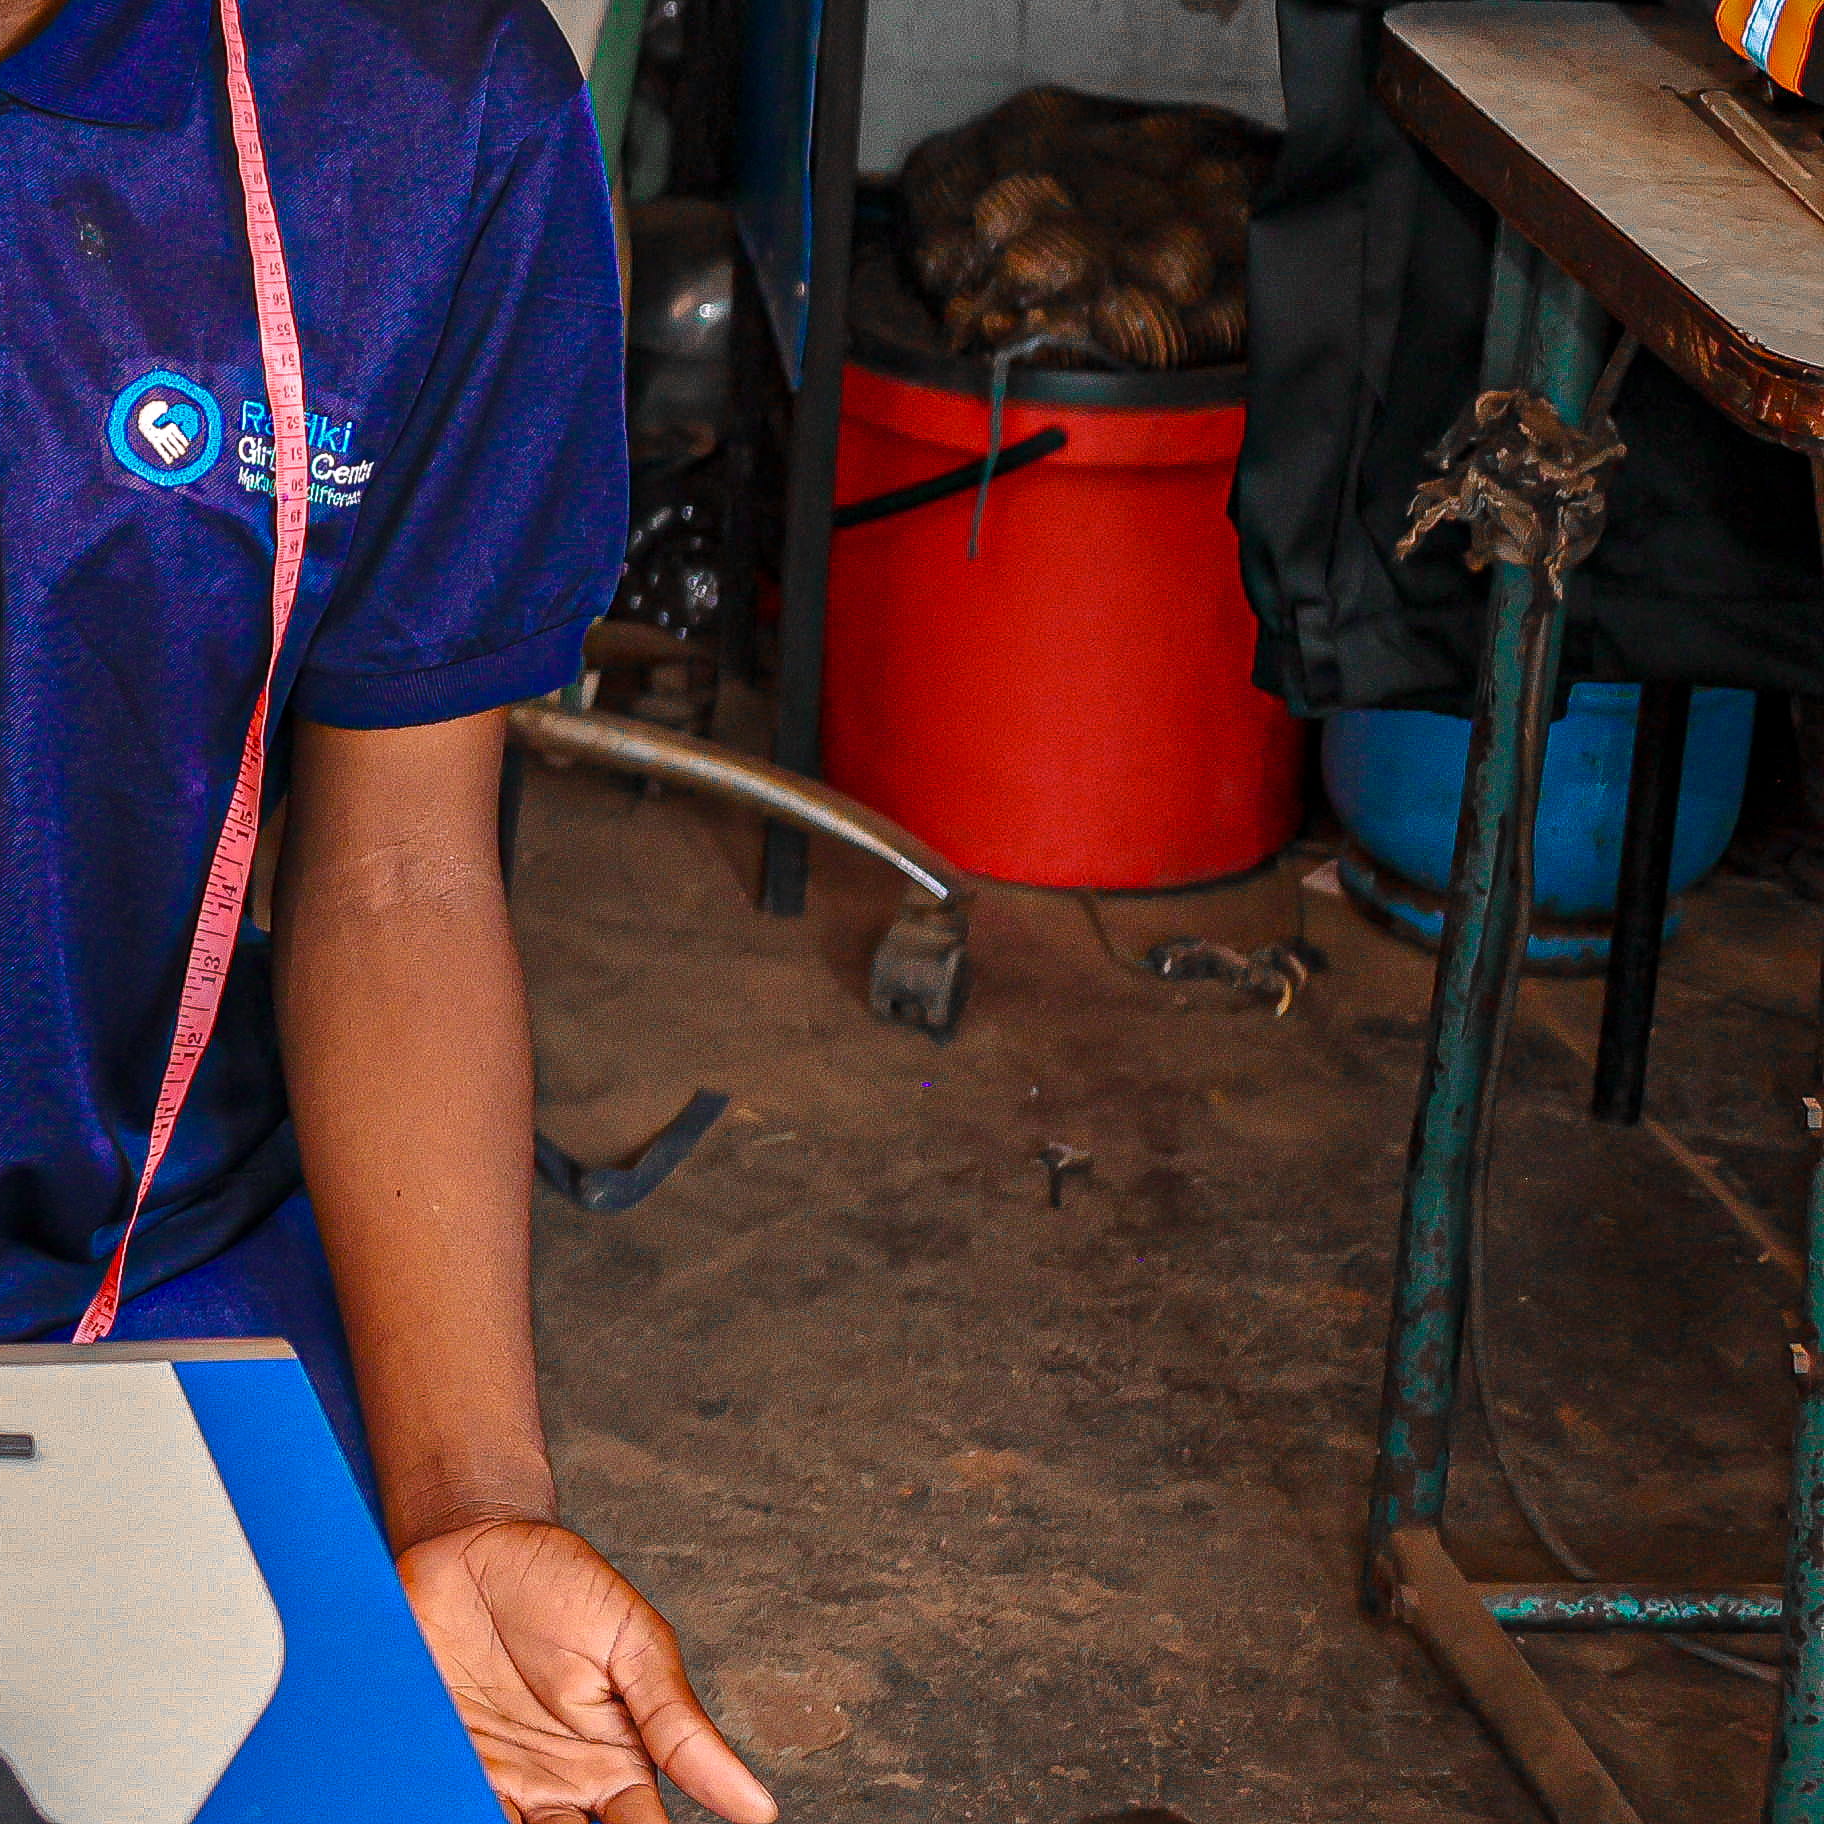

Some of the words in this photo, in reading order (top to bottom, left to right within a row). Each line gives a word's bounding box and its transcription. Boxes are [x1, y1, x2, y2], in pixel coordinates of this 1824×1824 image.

[273, 294, 285, 306] 56
[277, 324, 290, 336] 55
[287, 417, 300, 429] 52
[291, 447, 302, 459] 51
[291, 479, 303, 491] 50
